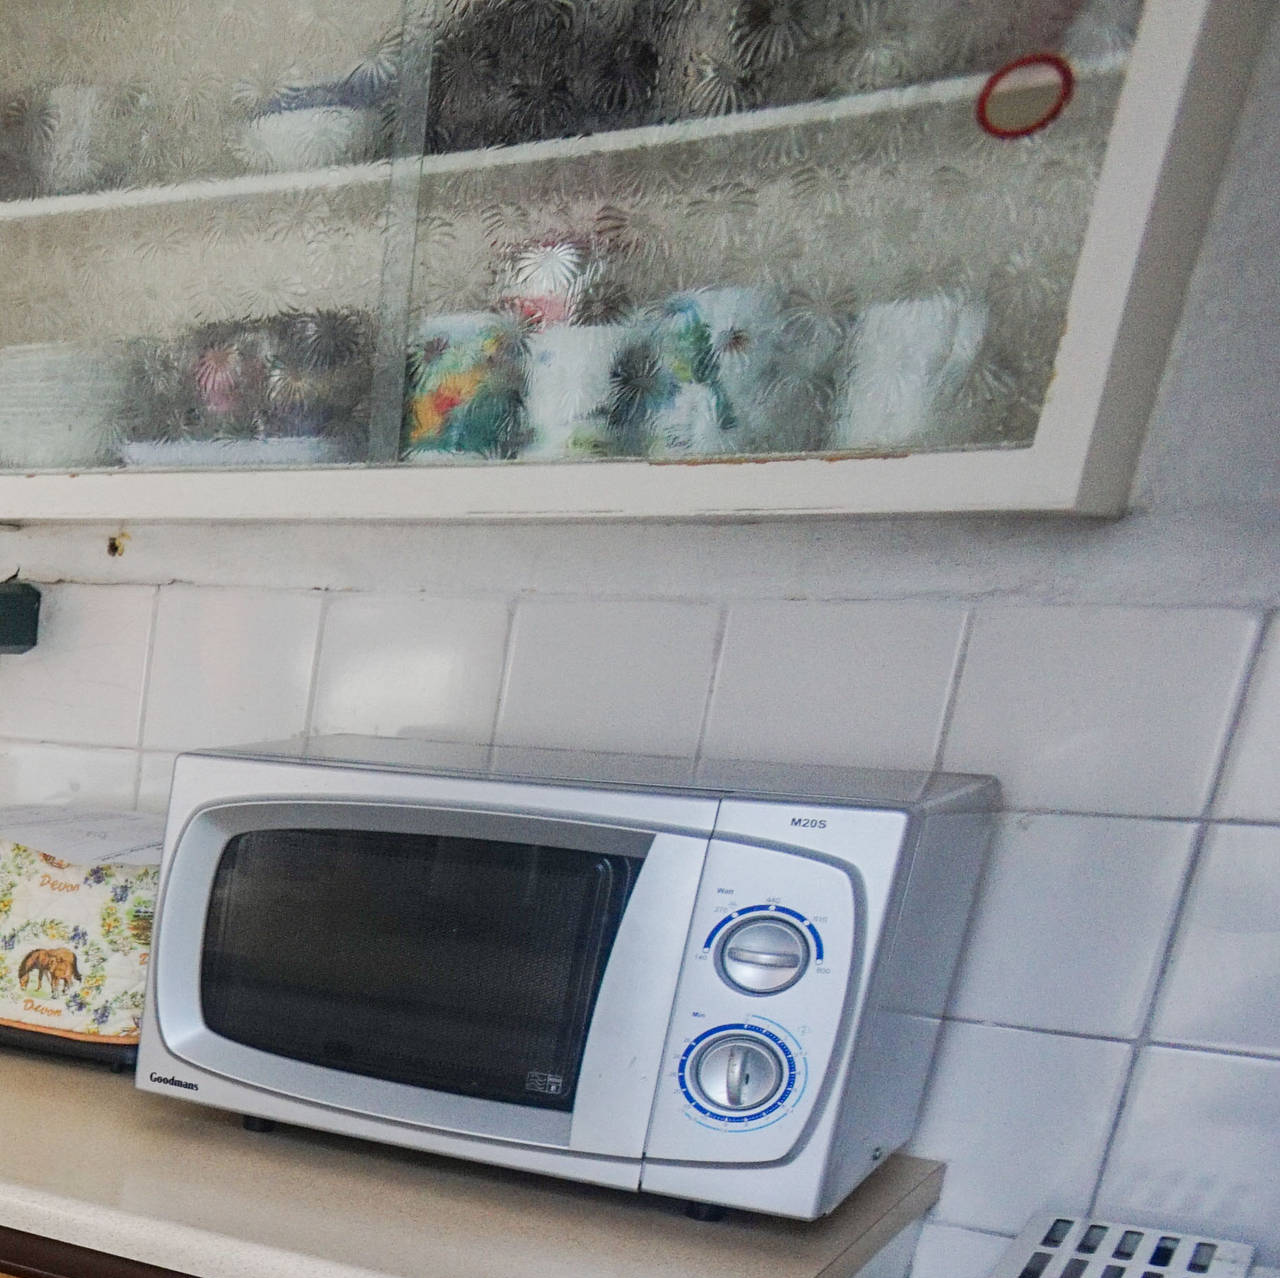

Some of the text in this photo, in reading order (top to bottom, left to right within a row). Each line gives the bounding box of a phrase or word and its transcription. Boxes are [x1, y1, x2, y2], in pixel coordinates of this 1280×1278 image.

[790, 817, 828, 829] M20S
[40, 873, 80, 893] Devon
[23, 998, 62, 1017] Devon
[149, 1071, 199, 1092] Goodmans
